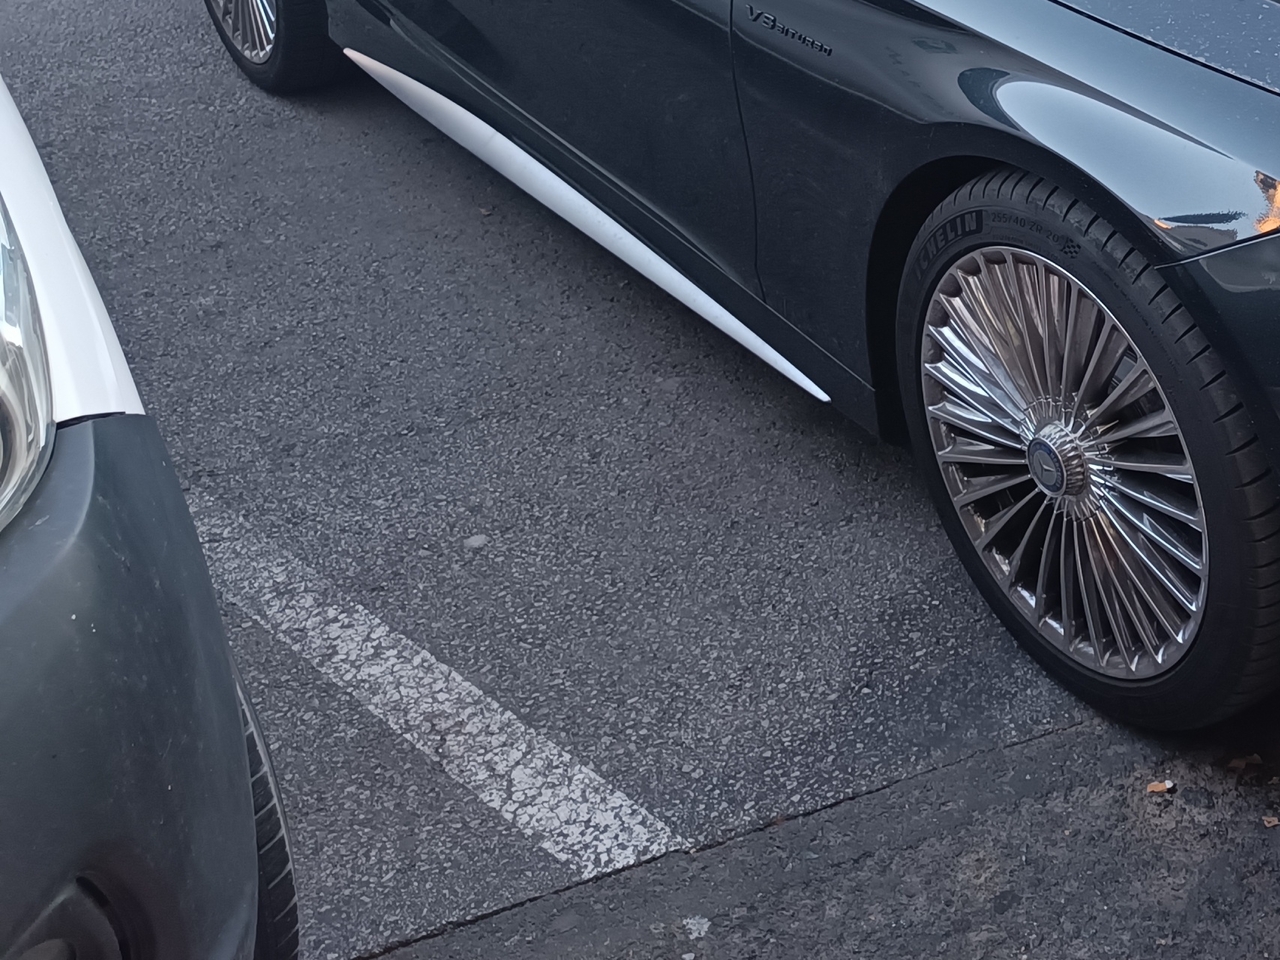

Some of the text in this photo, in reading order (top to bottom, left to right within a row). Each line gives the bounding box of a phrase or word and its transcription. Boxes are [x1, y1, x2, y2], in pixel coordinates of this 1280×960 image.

[914, 211, 978, 280] ICHELIN
[991, 212, 1026, 228] 255/40
[1029, 221, 1043, 234] ZR
[1046, 230, 1060, 243] 20
